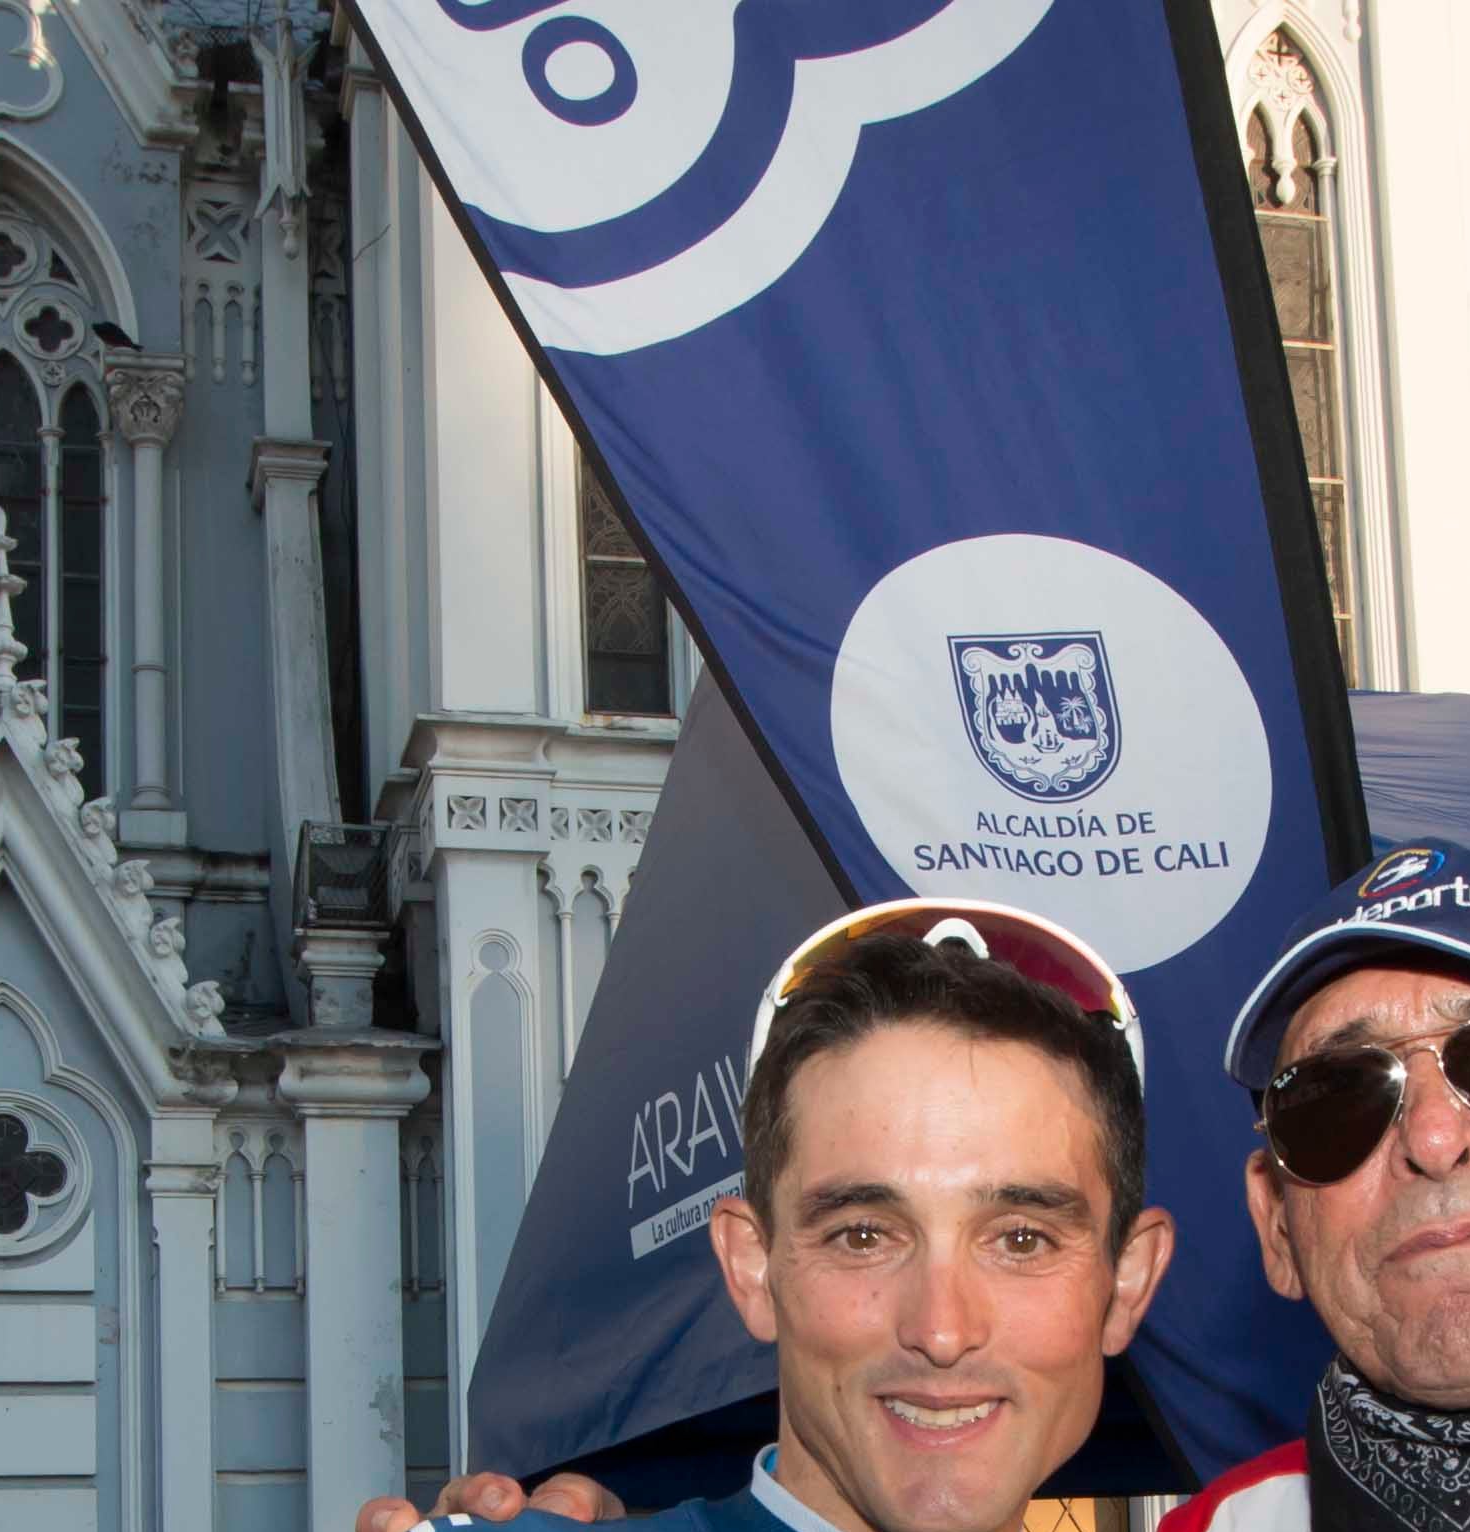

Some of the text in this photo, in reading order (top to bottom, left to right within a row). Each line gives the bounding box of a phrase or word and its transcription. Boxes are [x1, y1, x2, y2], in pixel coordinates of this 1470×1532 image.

[977, 809, 1156, 838] ALCALDÍA DE
[913, 841, 1229, 877] SANTIAGO DE CALI
[651, 1221, 665, 1245] La
[665, 1203, 702, 1238] cultura
